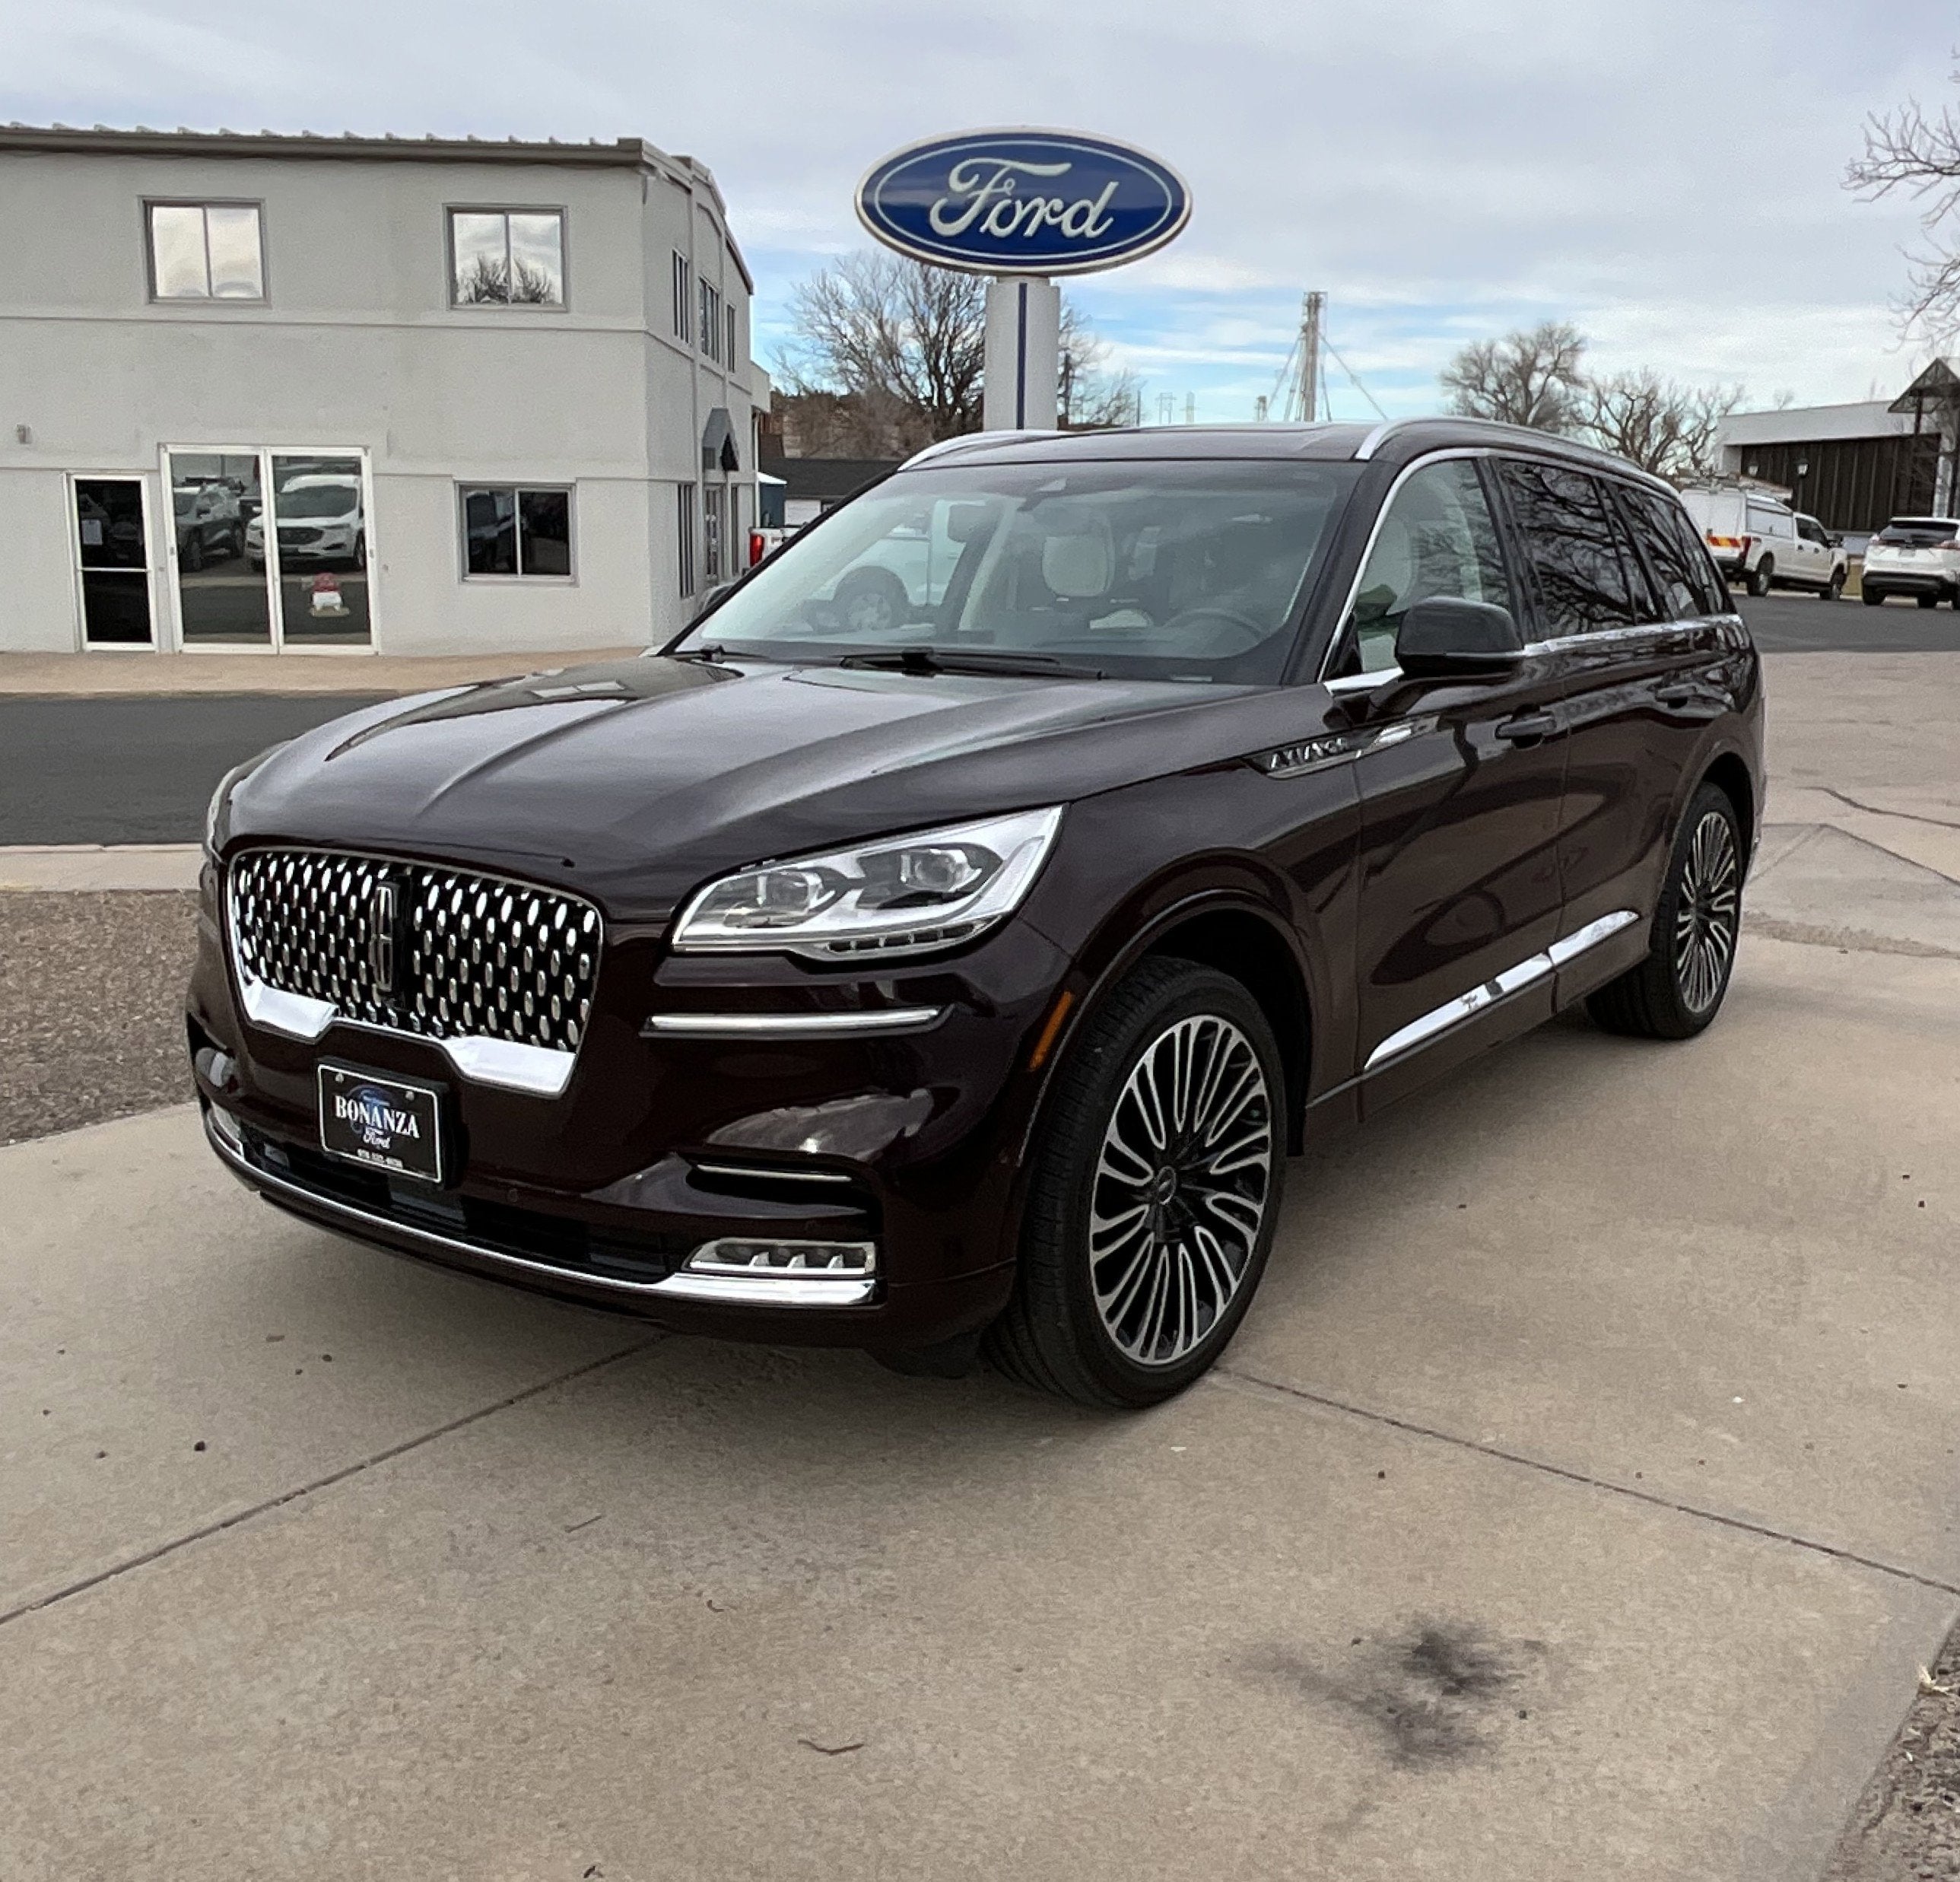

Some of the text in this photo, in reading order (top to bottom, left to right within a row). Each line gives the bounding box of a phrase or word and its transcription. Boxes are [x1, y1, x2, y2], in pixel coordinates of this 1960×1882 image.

[929, 157, 1119, 237] Ford
[335, 1095, 420, 1139] BONANZA
[363, 1127, 392, 1149] Ford
